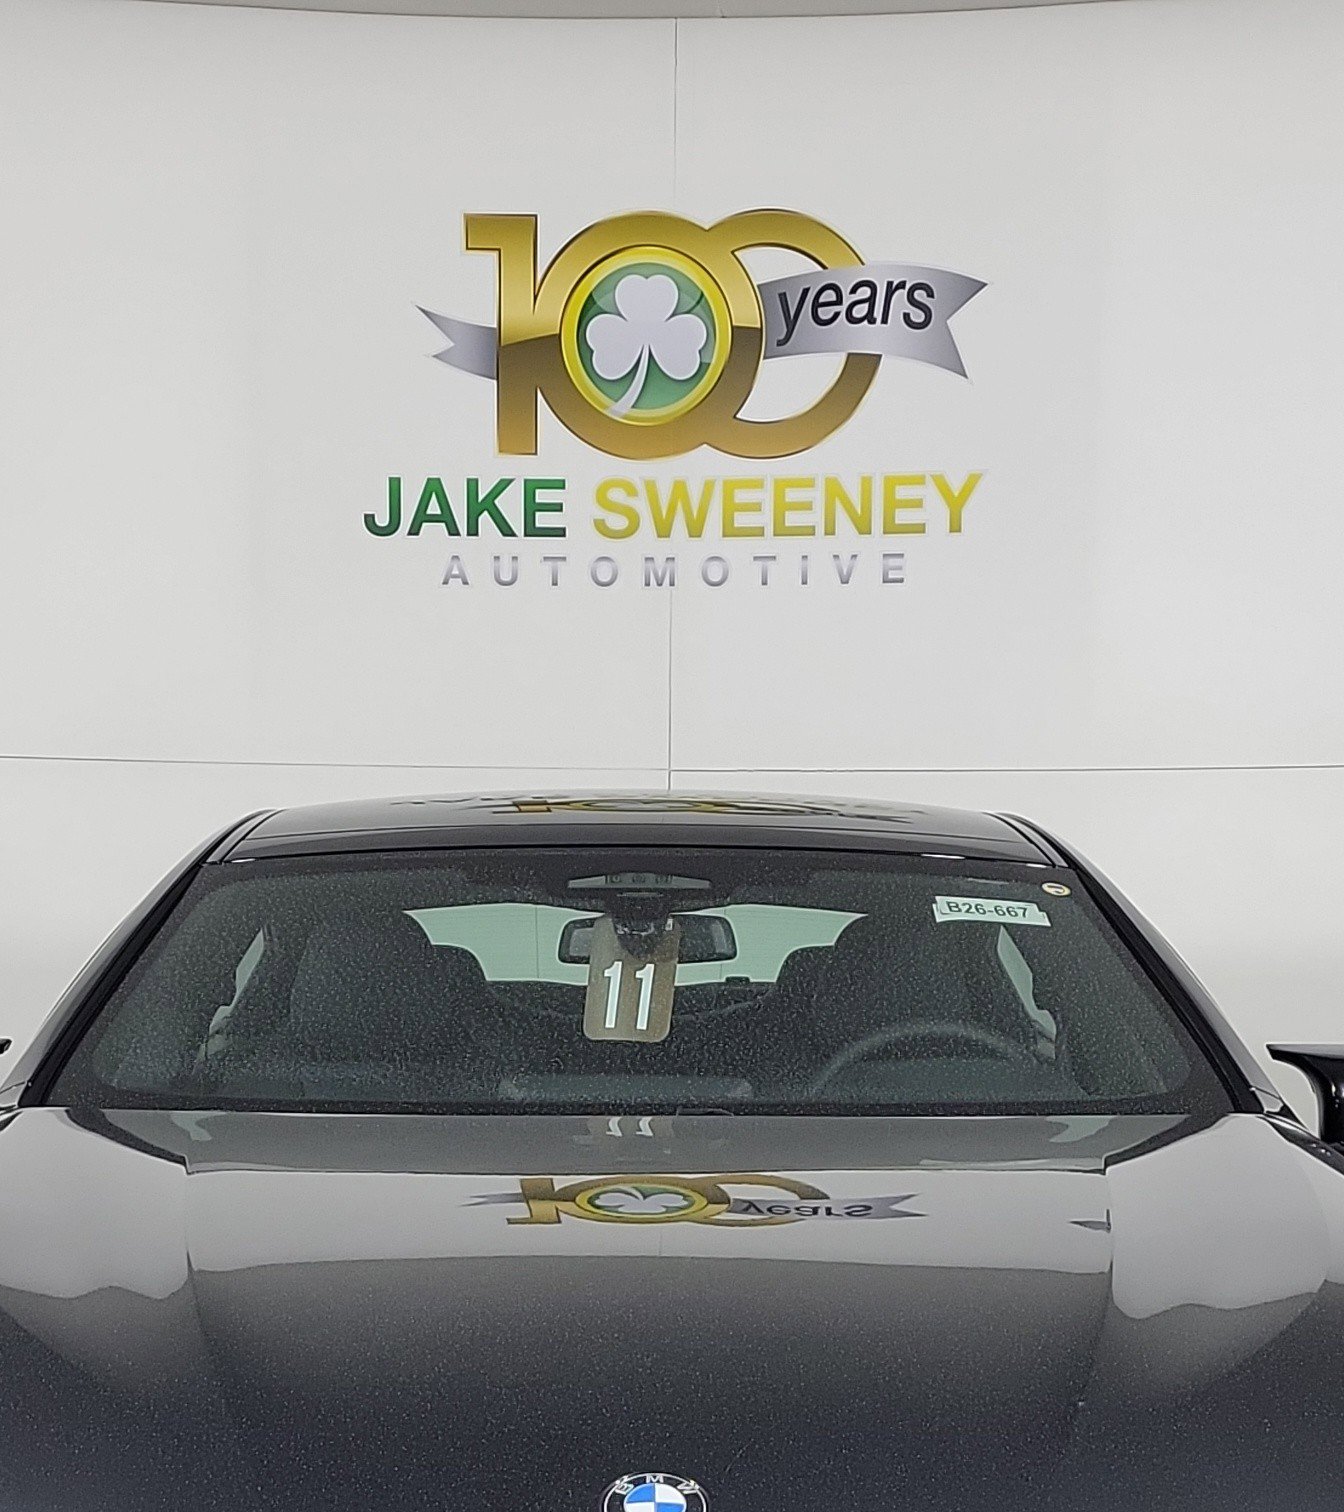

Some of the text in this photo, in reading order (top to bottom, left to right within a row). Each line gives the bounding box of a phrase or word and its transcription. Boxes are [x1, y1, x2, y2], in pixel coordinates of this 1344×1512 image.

[464, 208, 936, 459] 100 years
[362, 472, 983, 538] JAKE SWEENEY
[441, 552, 906, 587] AUTOMOTIVE
[946, 901, 1028, 918] B26-667
[604, 961, 655, 1030] 11
